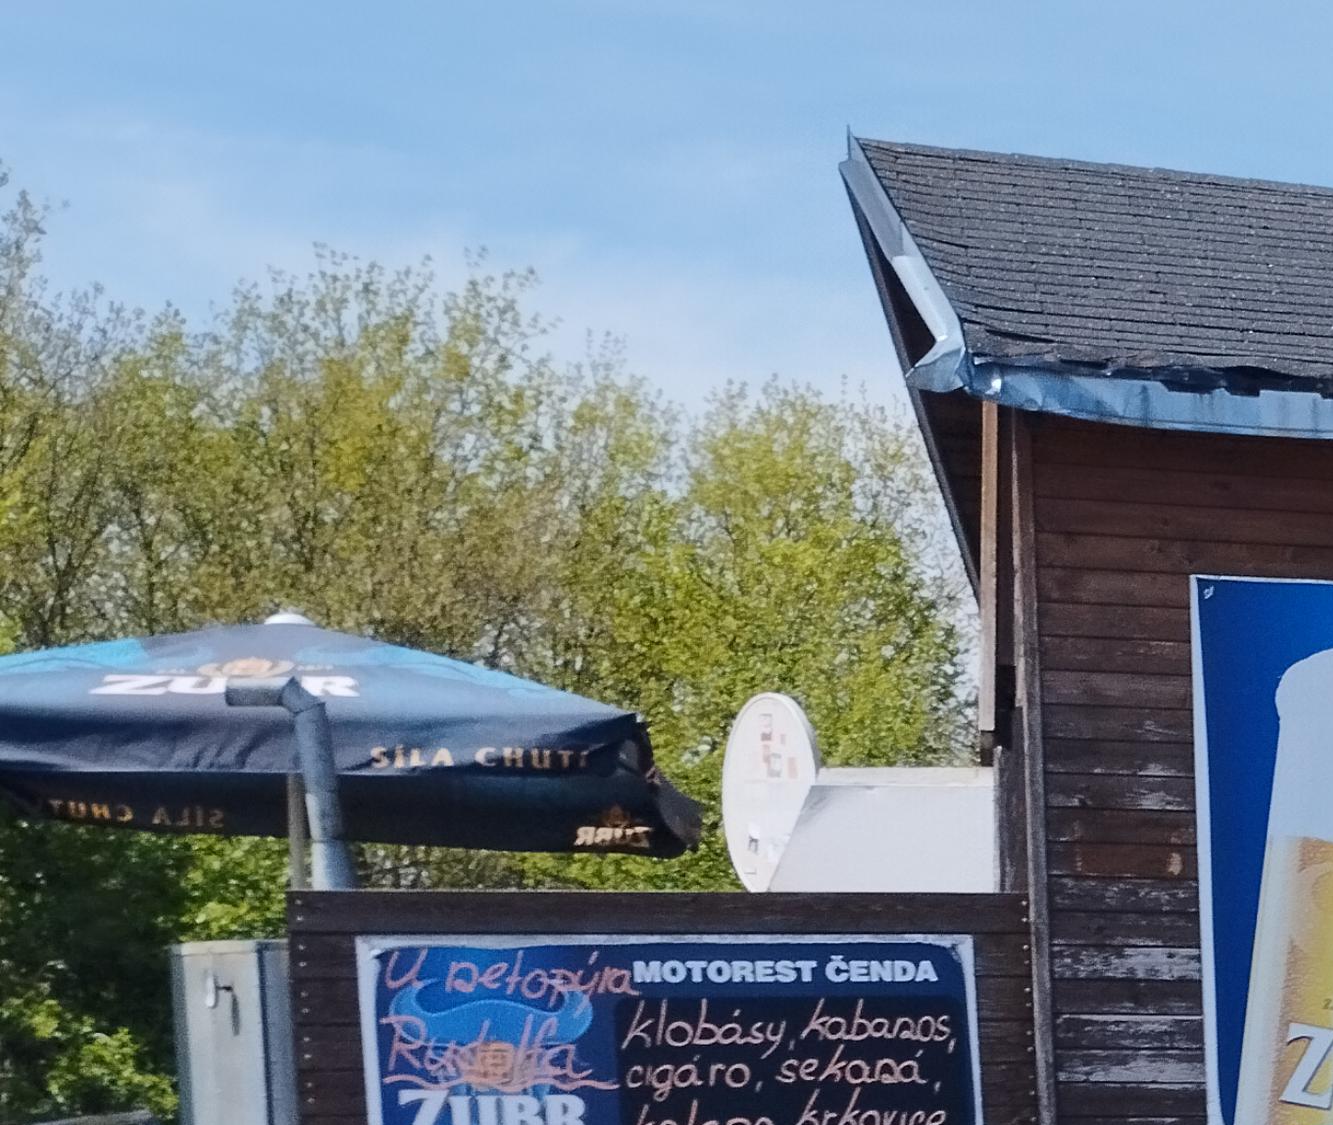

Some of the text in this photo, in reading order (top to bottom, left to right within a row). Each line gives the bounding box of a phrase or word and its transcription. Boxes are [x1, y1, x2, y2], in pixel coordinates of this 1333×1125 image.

[89, 673, 361, 697] ZUR
[384, 946, 428, 990] U
[634, 953, 940, 985] MOTOREST ČENDA
